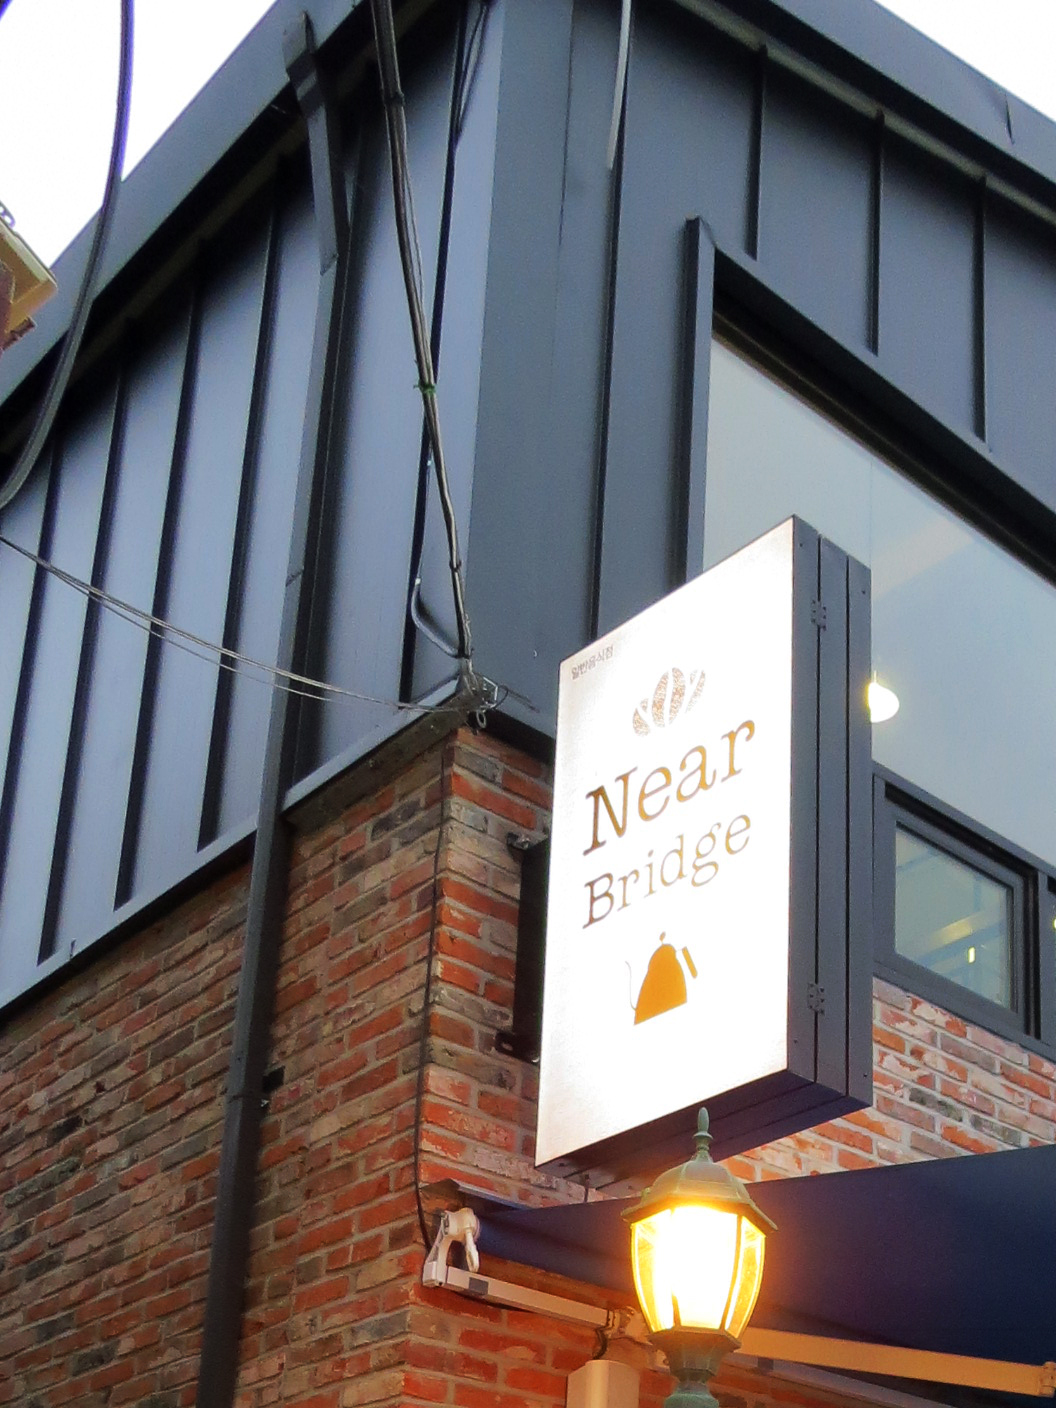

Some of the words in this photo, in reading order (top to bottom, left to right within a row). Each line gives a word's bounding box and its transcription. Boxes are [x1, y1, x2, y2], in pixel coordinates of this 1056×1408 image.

[571, 643, 614, 680] 일반음식점
[582, 719, 756, 857] Near
[582, 814, 752, 930] Bridge
